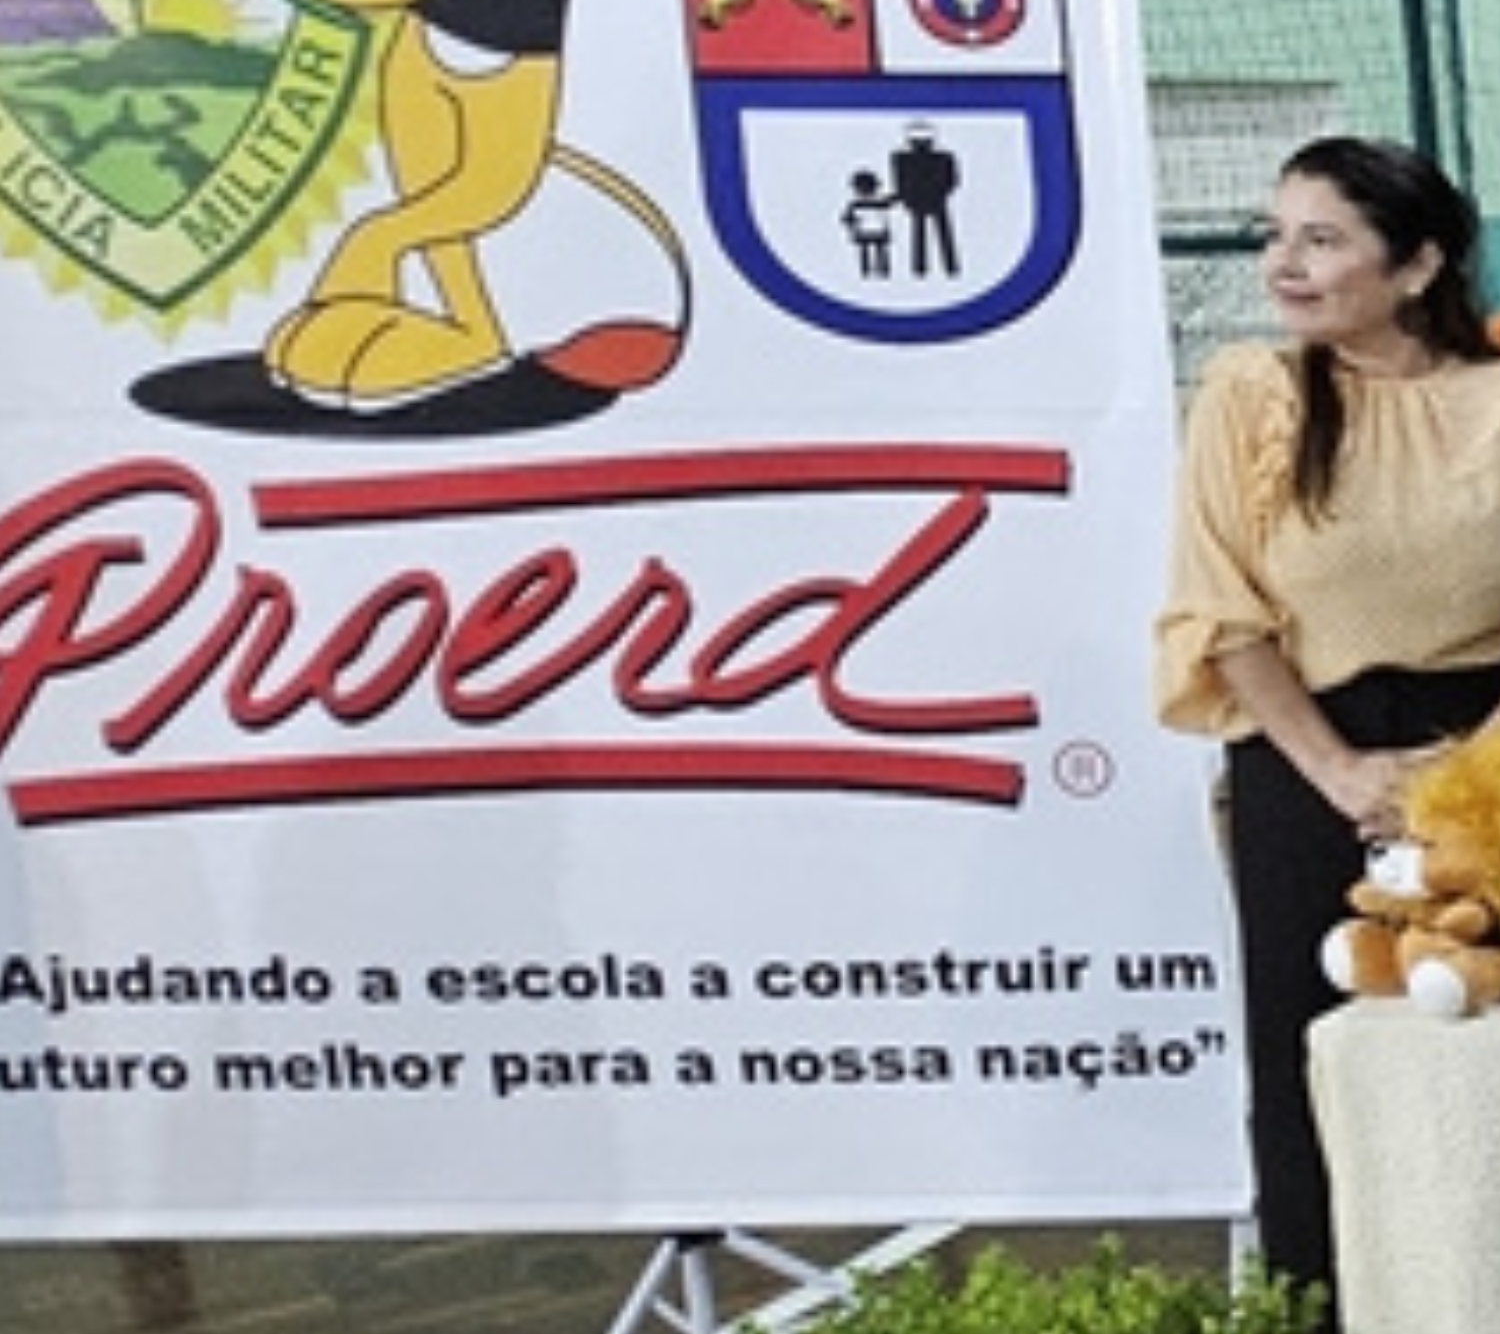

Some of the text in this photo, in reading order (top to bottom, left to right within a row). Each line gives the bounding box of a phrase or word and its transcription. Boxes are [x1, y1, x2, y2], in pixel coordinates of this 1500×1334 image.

[0, 40, 343, 257] ICIA MILITAR
[0, 457, 1040, 755] Proerd
[360, 966, 400, 1004] a
[426, 953, 664, 1003] escola
[690, 962, 730, 998] a
[754, 947, 1092, 998] construir
[1115, 953, 1218, 992] um
[215, 1043, 465, 1091] melhor
[489, 1049, 651, 1099] para
[676, 1047, 717, 1084] a
[740, 1044, 952, 1084] nossa
